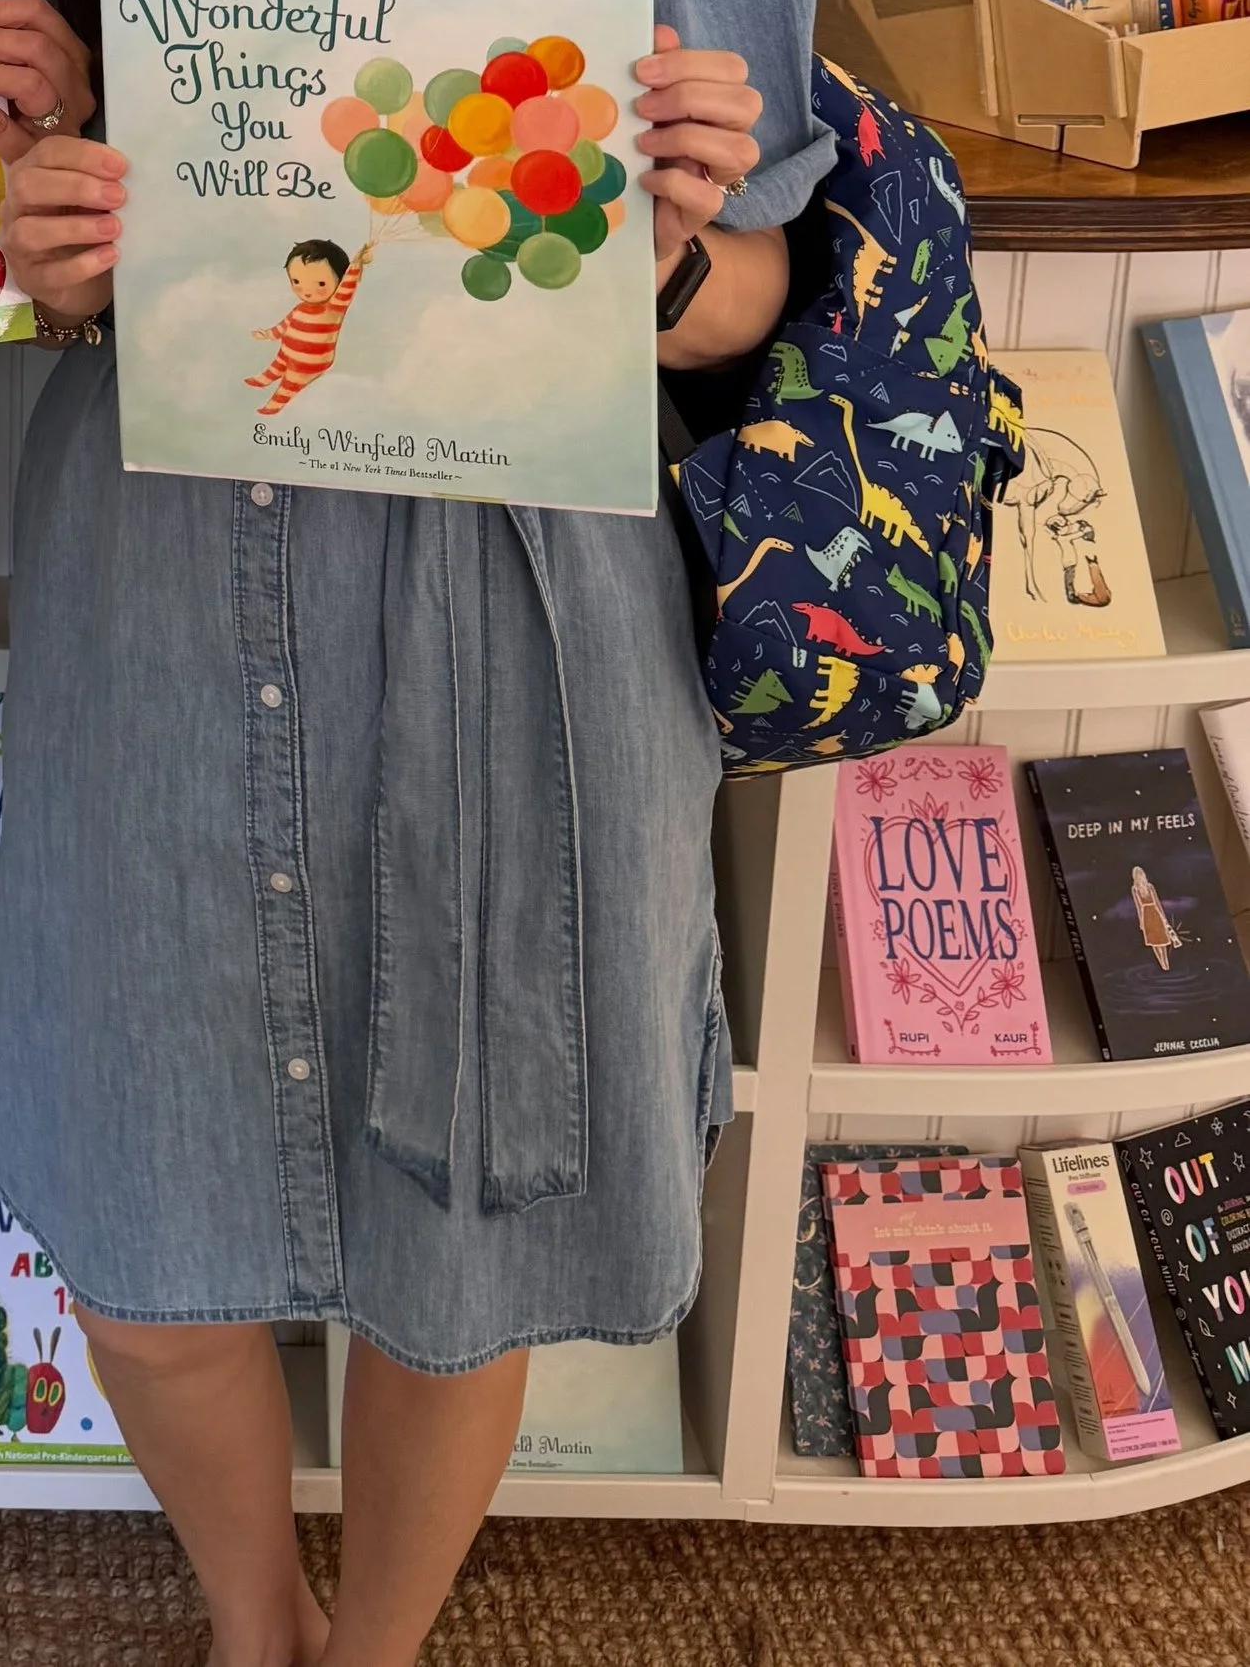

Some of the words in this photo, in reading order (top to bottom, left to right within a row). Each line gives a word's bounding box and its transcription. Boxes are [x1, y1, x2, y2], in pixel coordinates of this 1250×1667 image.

[164, 39, 327, 107] Things
[211, 101, 292, 152] You
[176, 160, 269, 197] Will
[276, 161, 336, 199] Be
[252, 422, 311, 454] Emily
[318, 428, 415, 461] Winfield
[426, 437, 512, 468] Martin
[308, 459, 327, 470] The
[343, 462, 361, 473] New
[364, 464, 381, 474] York
[384, 466, 407, 477] Times
[409, 468, 453, 481] Bestseller
[1068, 821, 1102, 839] DEEP
[1108, 820, 1123, 835] IN
[1130, 817, 1152, 833] MY
[1157, 813, 1195, 831] FEELS
[868, 816, 1009, 893] LOVE
[880, 896, 1018, 961] POEMS
[900, 1033, 930, 1044] RUPI
[994, 1032, 1028, 1045] KAUR
[1154, 1040, 1186, 1053] JENNAE
[1189, 1037, 1220, 1050] CECELIA
[1053, 1152, 1110, 1173] Lifelines
[1164, 1152, 1219, 1205] OUT
[1131, 1182, 1146, 1206] OUT
[1140, 1208, 1152, 1223] OF
[1149, 1230, 1165, 1261] YOUR
[1161, 1265, 1177, 1296] MIND
[1185, 1217, 1220, 1263] OF
[5, 1449, 41, 1461] National
[43, 1450, 117, 1464] Pre-Kindergarten
[538, 1435, 593, 1455] Martin
